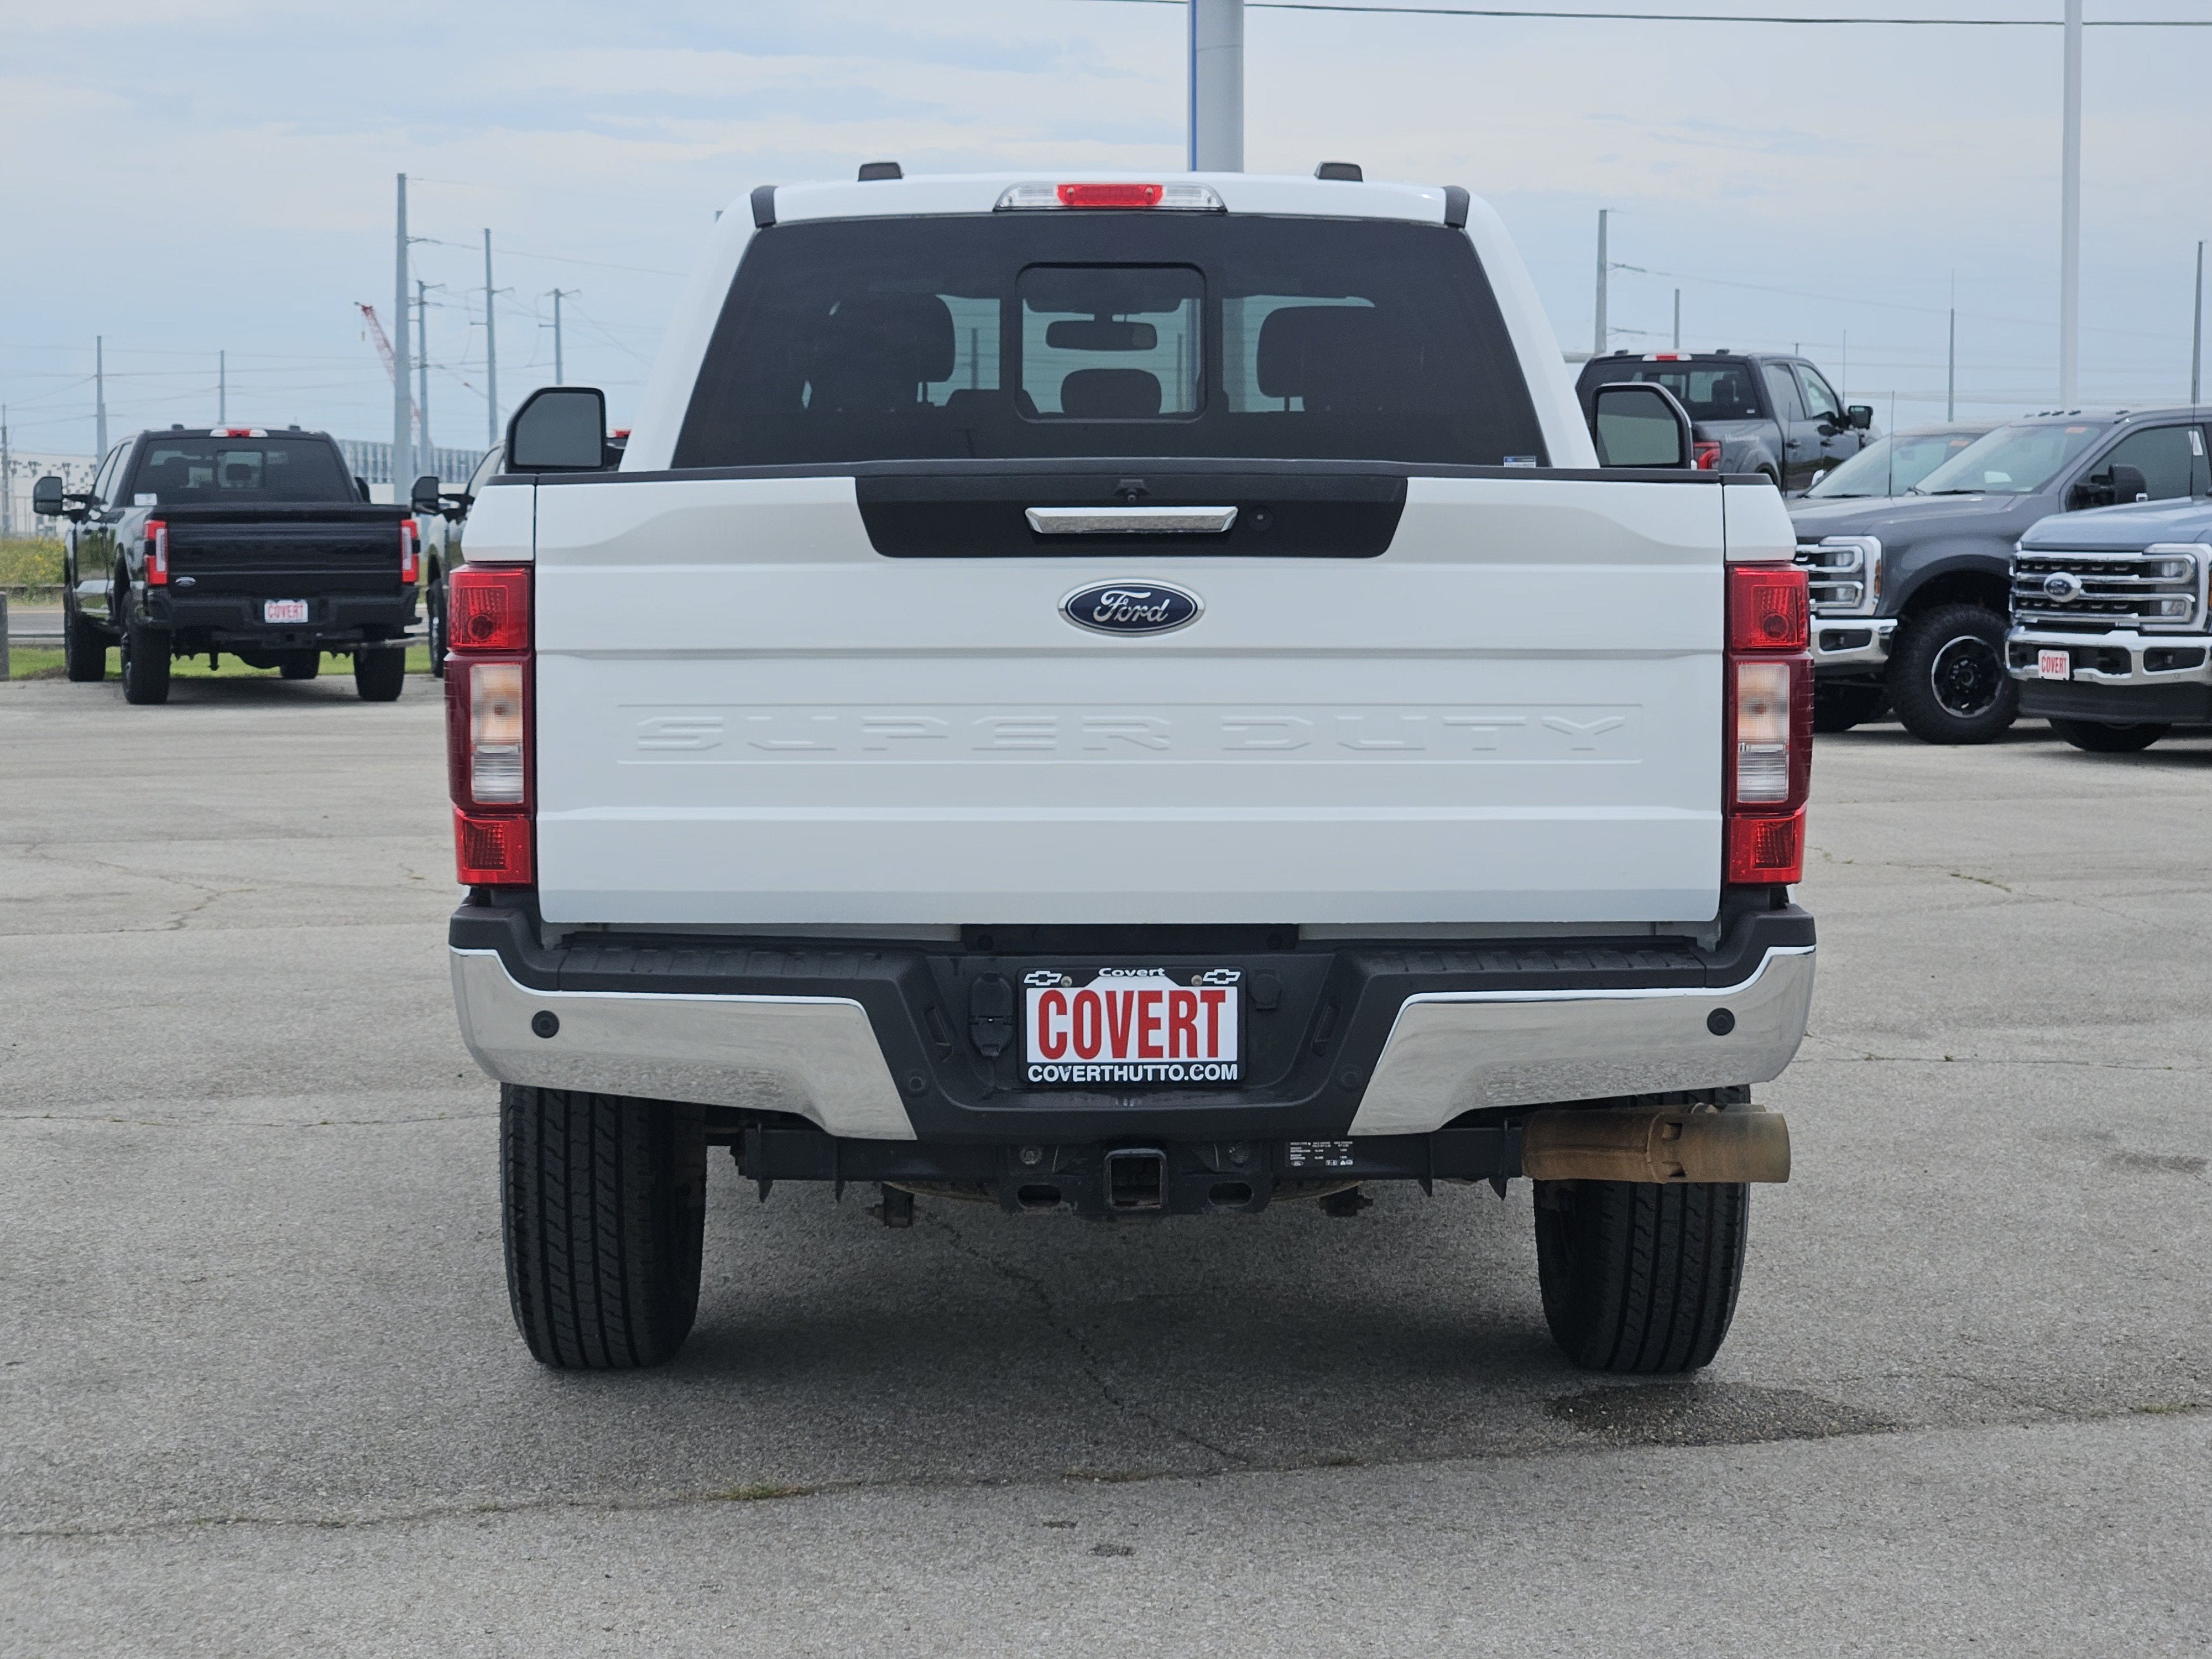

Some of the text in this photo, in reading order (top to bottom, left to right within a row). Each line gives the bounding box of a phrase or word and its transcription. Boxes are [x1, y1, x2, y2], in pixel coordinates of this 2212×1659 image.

[1093, 589, 1170, 622] Ford
[2041, 656, 2067, 673] COVERT
[637, 716, 1627, 752] SUPER DUTY
[1098, 967, 1166, 978] Covert
[1037, 989, 1227, 1060] COVERT
[1027, 1063, 1239, 1082] COVERTHUTTO.COM
